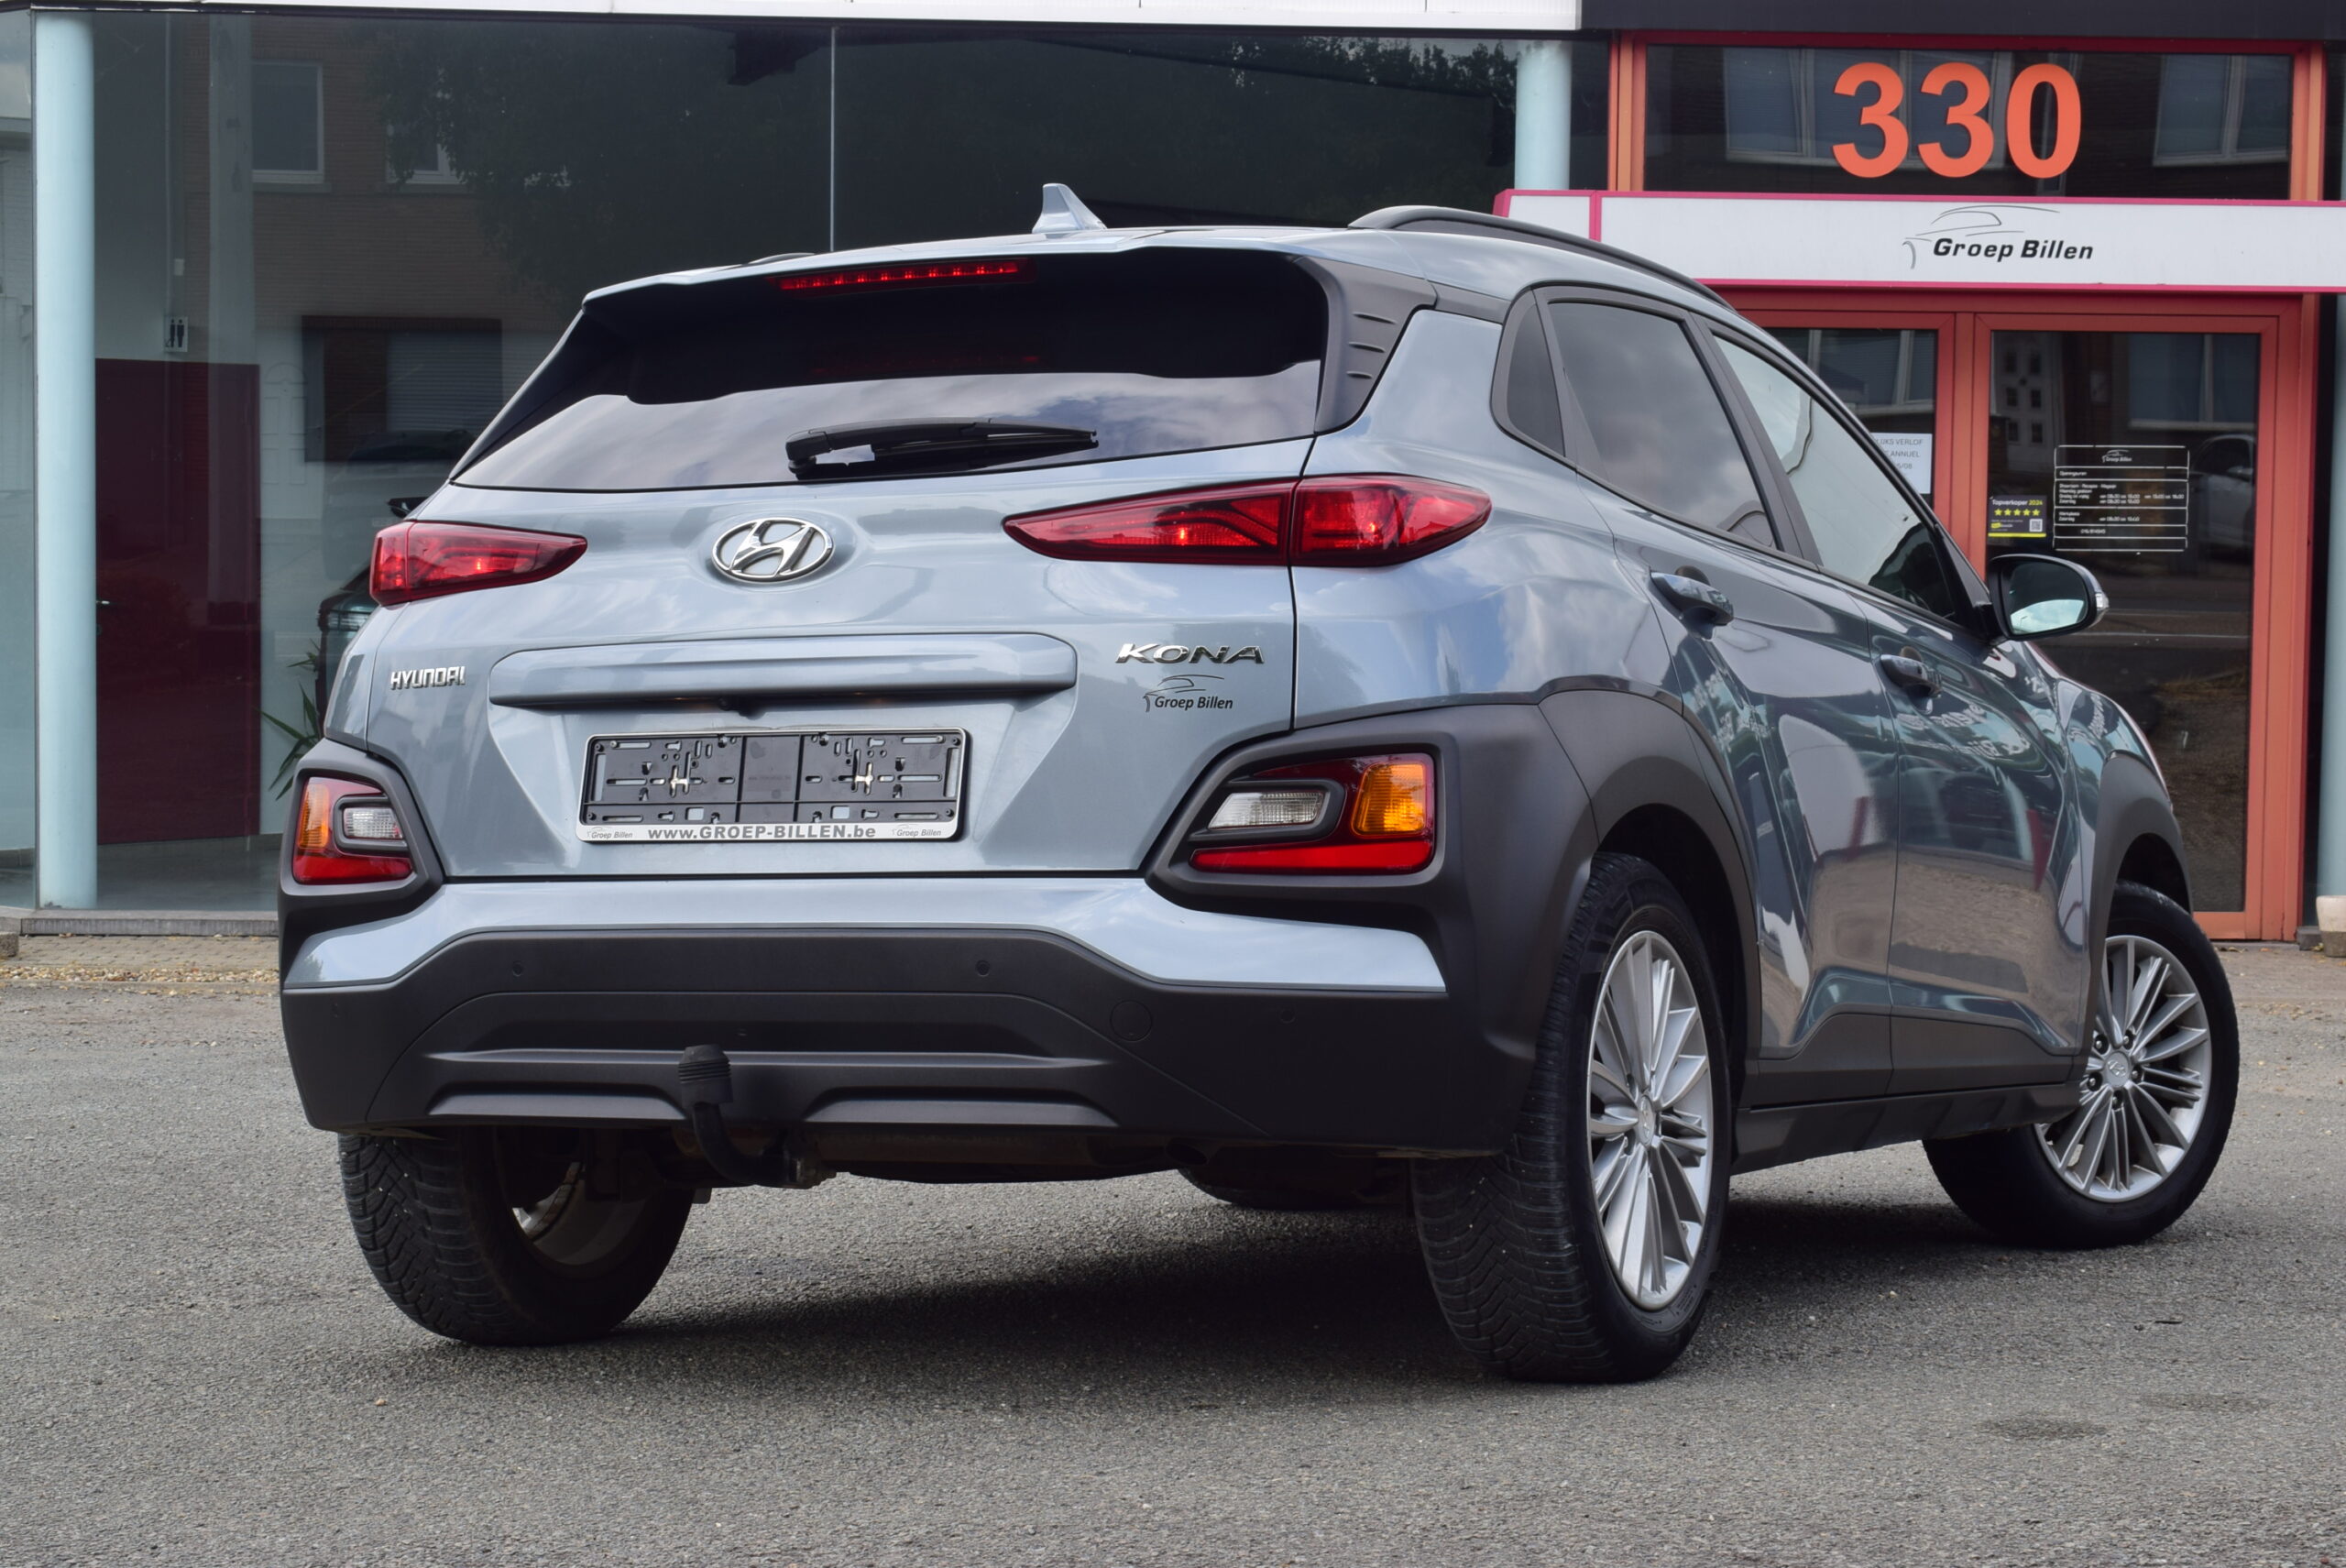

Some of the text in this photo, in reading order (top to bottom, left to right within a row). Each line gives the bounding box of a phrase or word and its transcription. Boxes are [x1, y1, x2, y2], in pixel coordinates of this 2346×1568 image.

[1832, 62, 2082, 179] 330
[1933, 237, 2094, 263] Groep Billen
[1115, 643, 1265, 664] KONA
[390, 665, 466, 690] HYUNDAI
[1154, 696, 1233, 711] Groep Billen
[591, 830, 633, 840] Groep Billen
[648, 825, 876, 839] www.GROEP-BILLEN.be
[896, 828, 942, 838] Groep Billen
